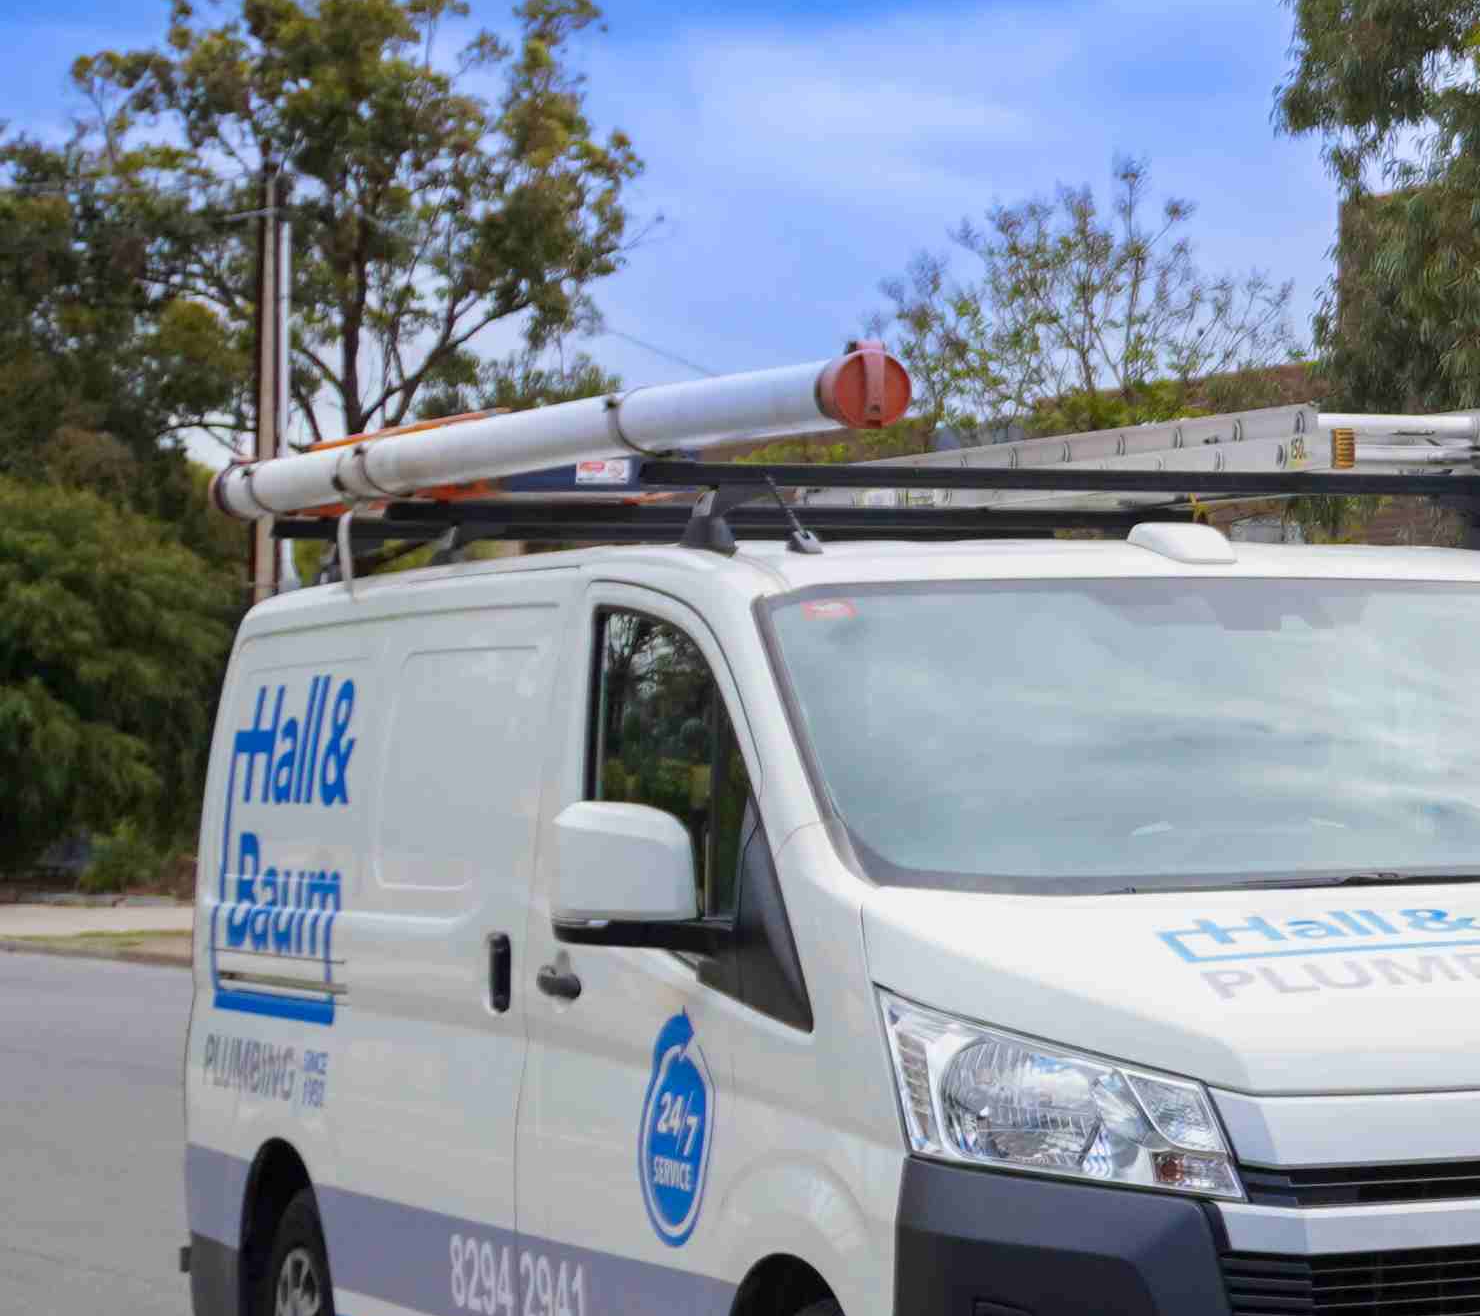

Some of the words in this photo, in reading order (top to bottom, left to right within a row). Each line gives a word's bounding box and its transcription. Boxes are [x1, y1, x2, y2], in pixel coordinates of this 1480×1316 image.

[226, 832, 341, 956] Baum
[204, 1033, 297, 1102] PLUMBING
[656, 1089, 699, 1158] 24/7
[654, 1154, 692, 1192] SERVICE
